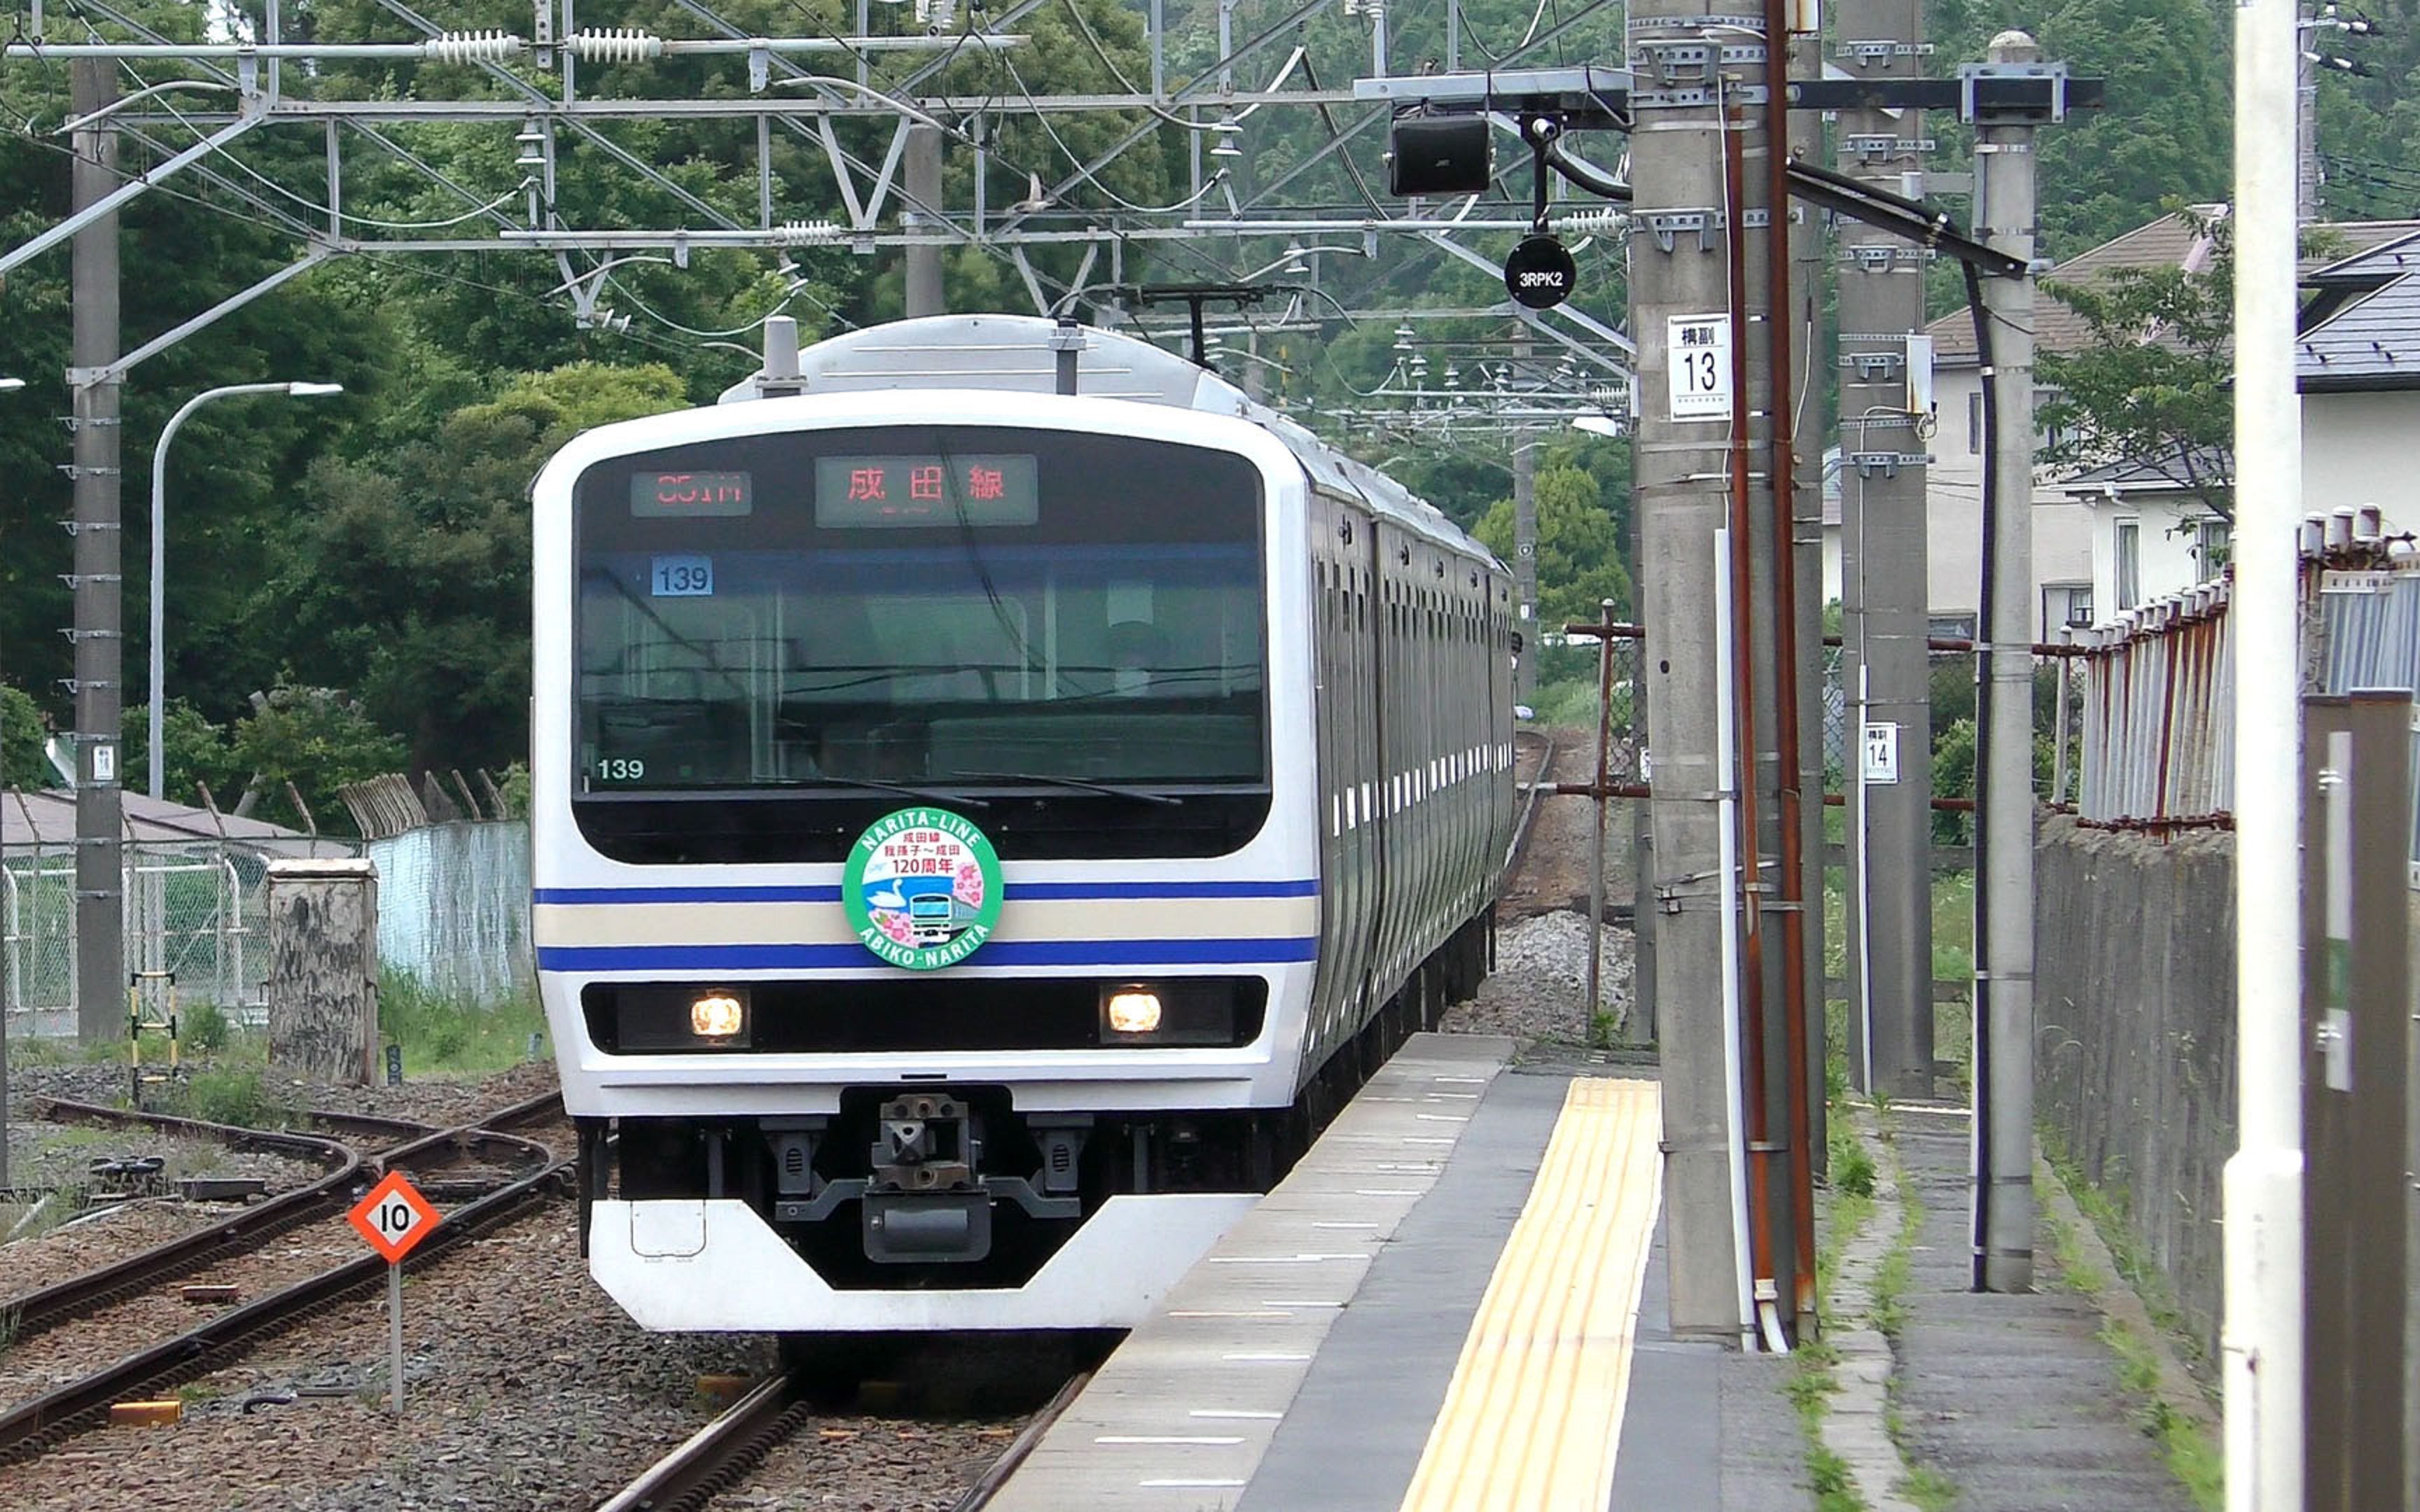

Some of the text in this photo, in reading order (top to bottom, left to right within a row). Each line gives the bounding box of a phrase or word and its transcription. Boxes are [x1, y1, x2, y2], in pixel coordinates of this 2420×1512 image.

[1519, 271, 1563, 287] 3RPK2
[1684, 351, 1716, 391] 13
[847, 464, 1004, 501] 成田線
[660, 566, 708, 592] 139
[1869, 743, 1887, 766] 14
[597, 759, 644, 780] 139
[861, 811, 981, 852] NARITA-LINE
[903, 832, 940, 843] 成田線
[892, 858, 954, 874] 120周年
[859, 923, 989, 967] ABIKO-NARITA
[381, 1203, 410, 1233] 10
